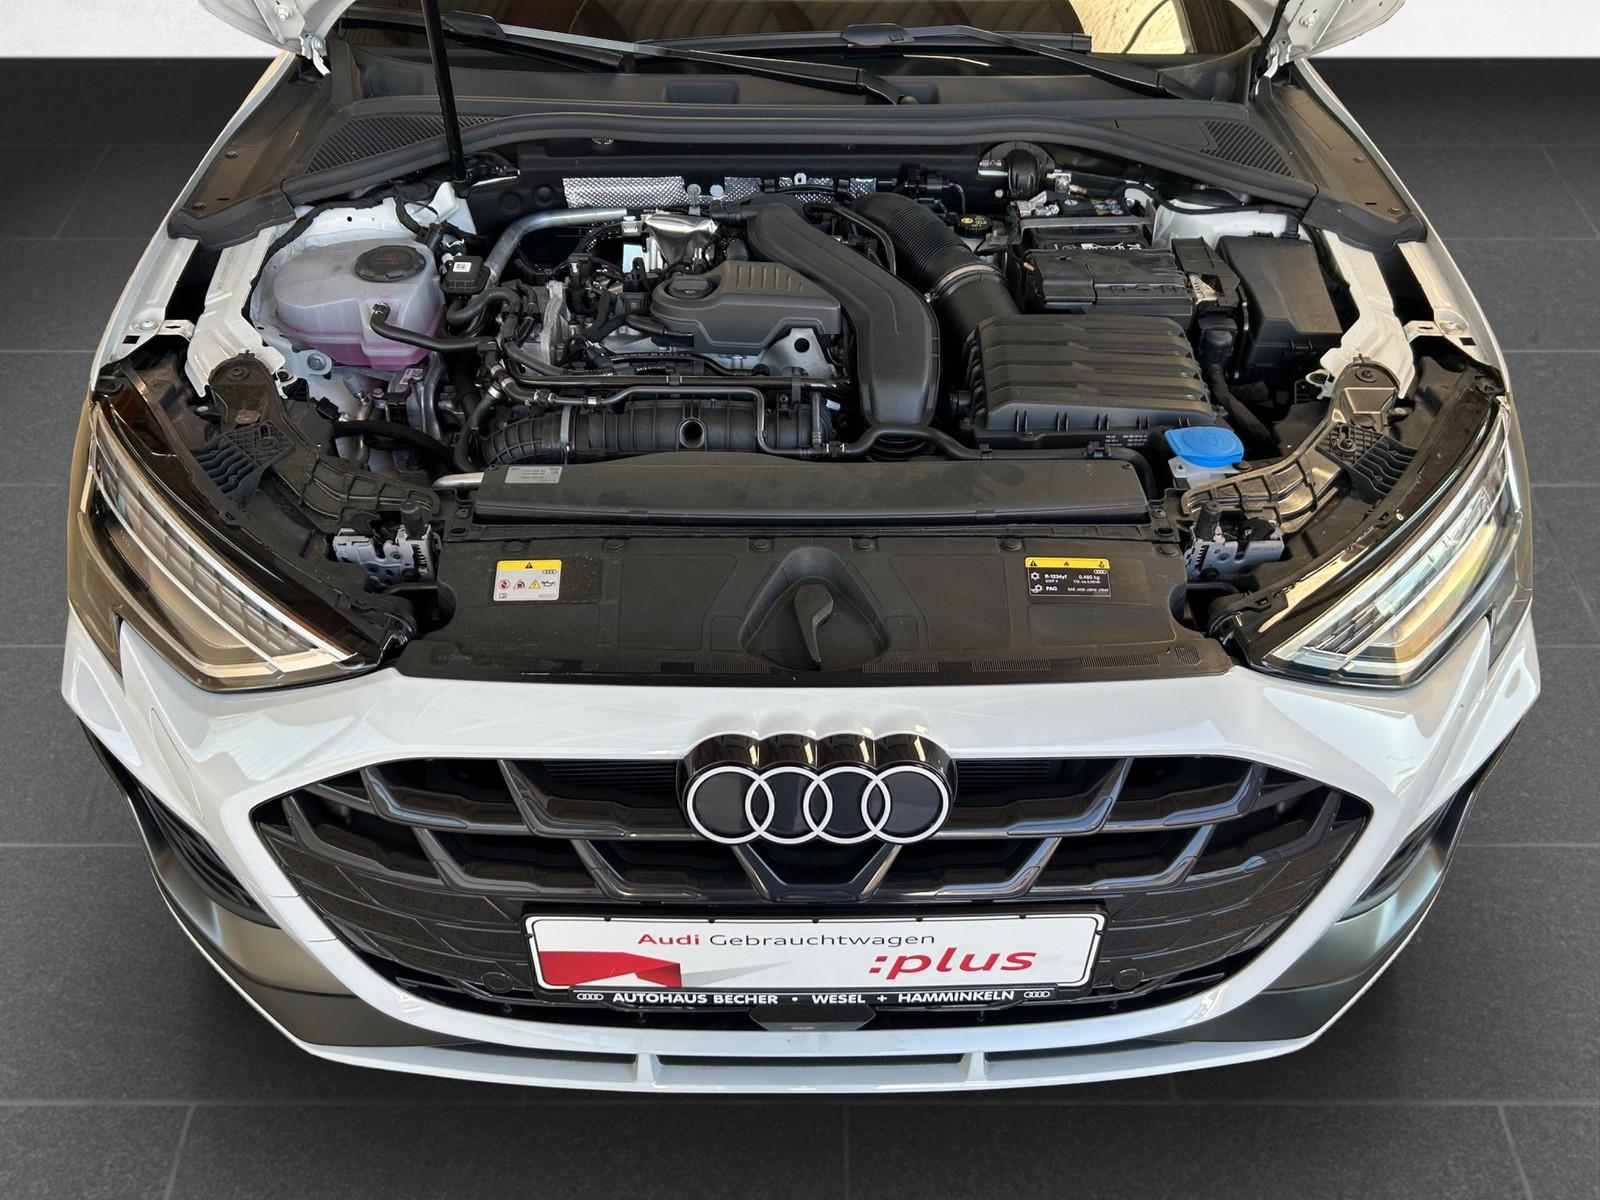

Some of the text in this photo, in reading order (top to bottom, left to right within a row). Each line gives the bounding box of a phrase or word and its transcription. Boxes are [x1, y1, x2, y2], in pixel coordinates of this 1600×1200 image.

[637, 933, 935, 947] Audi Gebrauchtwagen
[612, 992, 708, 1004] AUTOHAUS
[713, 993, 779, 1005] BECHER
[811, 994, 866, 1004] WESEL
[897, 990, 1015, 1004] HAMMINKELN
